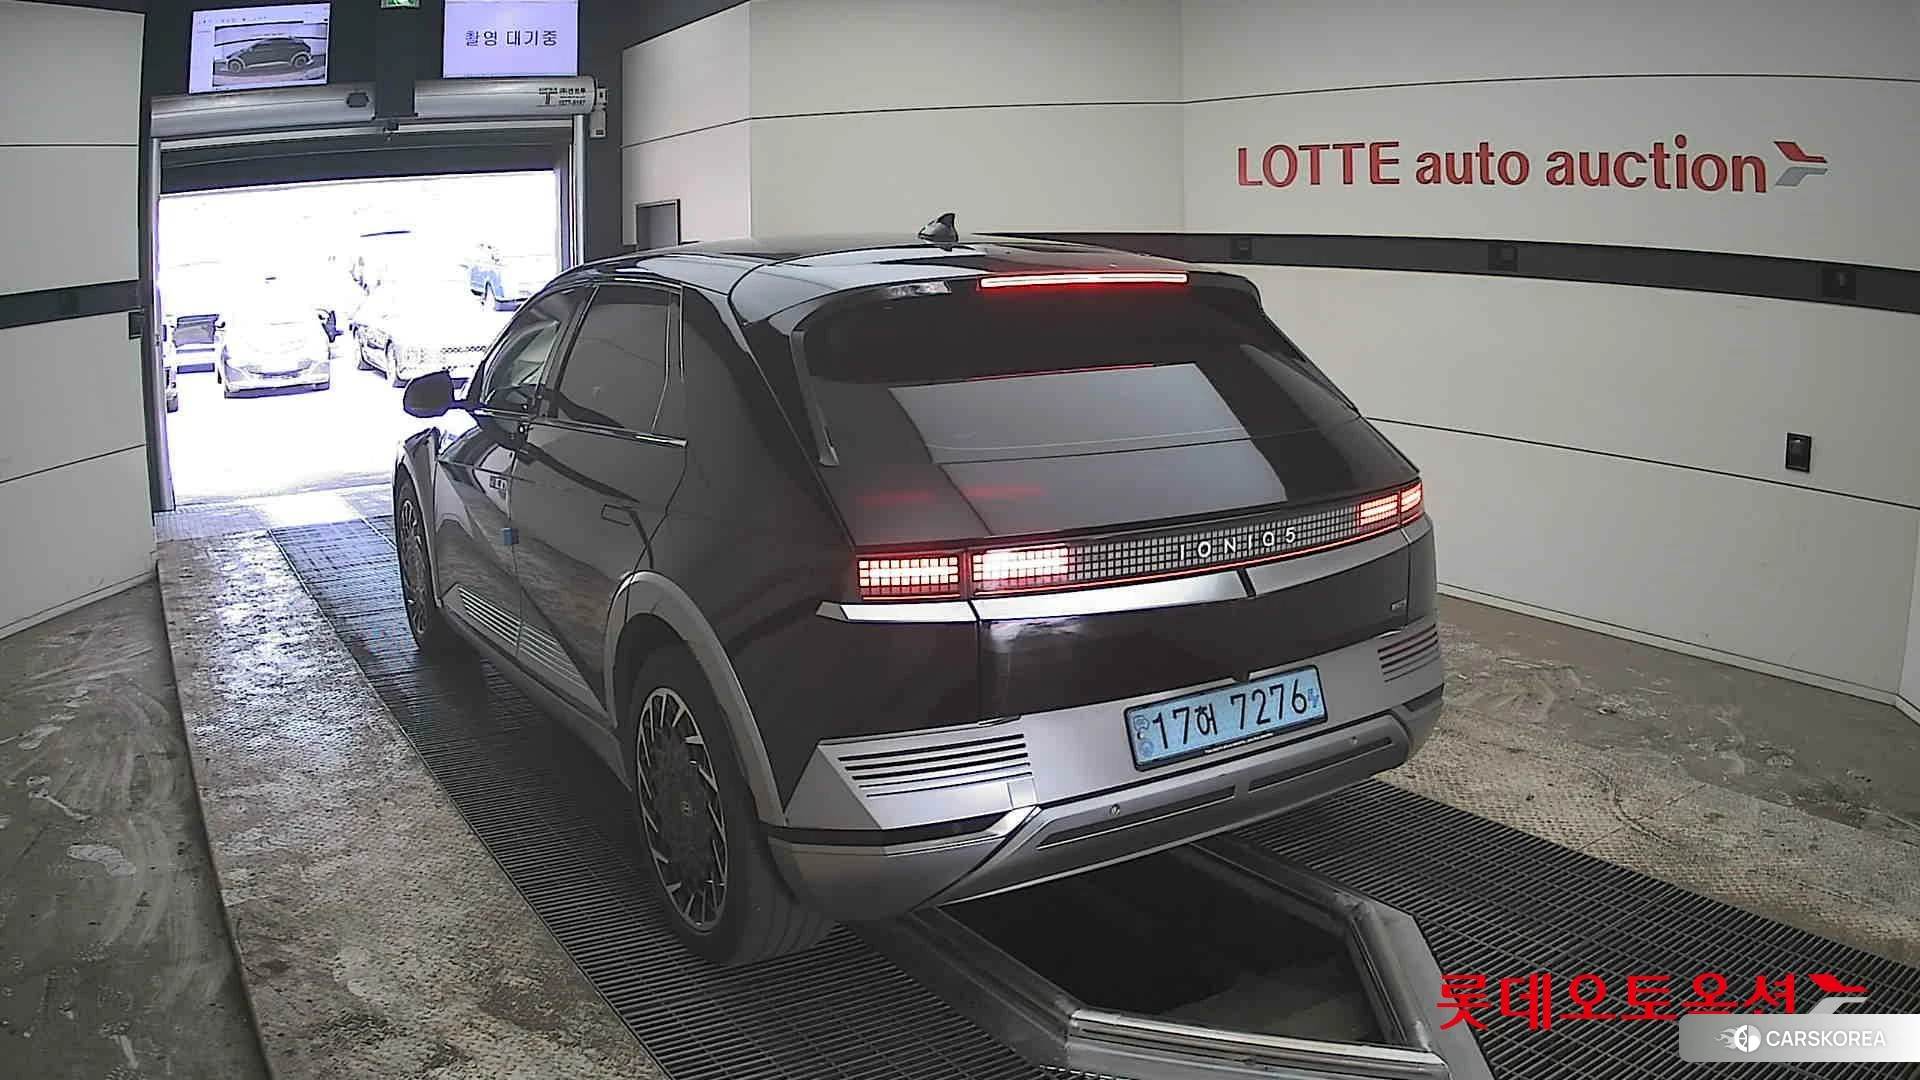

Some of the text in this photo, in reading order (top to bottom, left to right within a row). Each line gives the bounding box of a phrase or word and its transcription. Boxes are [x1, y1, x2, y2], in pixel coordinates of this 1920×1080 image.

[465, 30, 557, 47] 촬영 대기중
[1238, 134, 1767, 193] LOTTE auto auction
[1152, 679, 1308, 750] 17허 7276
